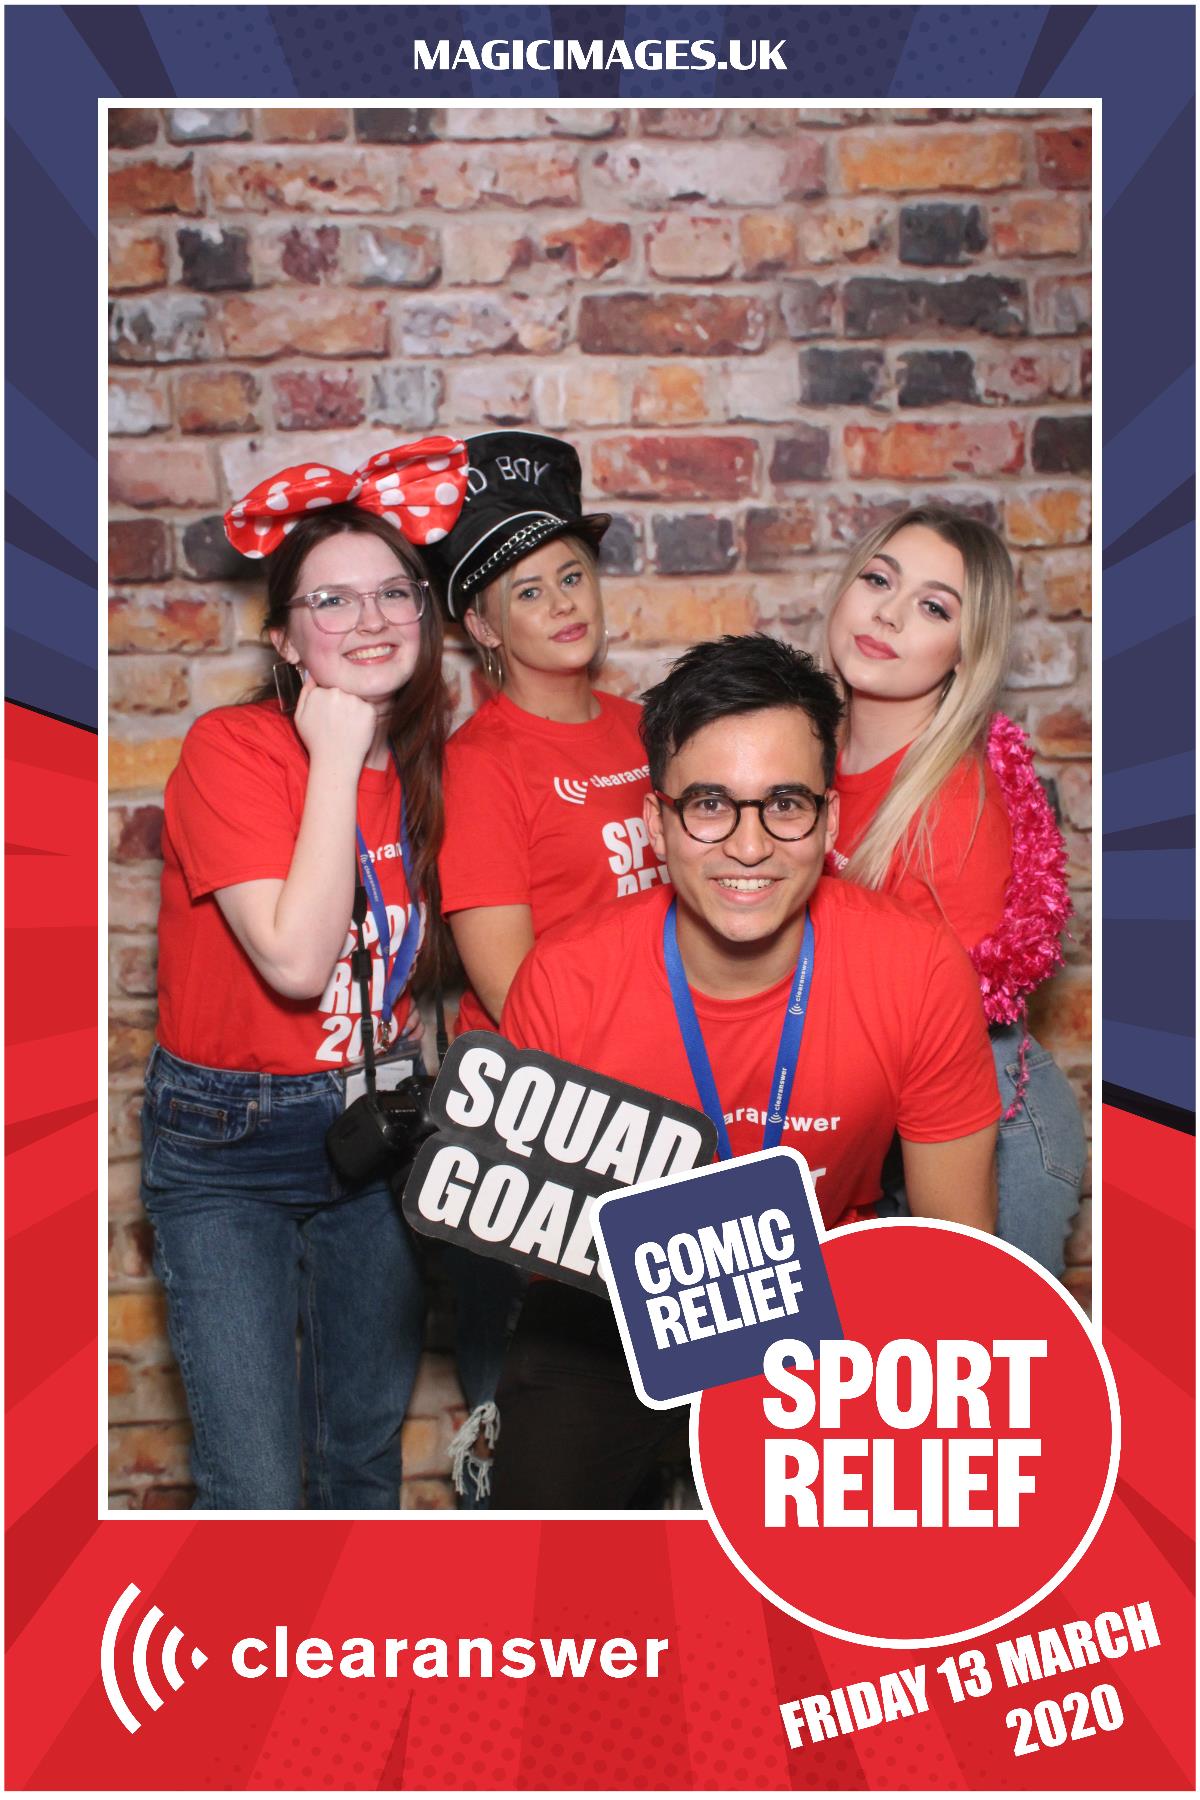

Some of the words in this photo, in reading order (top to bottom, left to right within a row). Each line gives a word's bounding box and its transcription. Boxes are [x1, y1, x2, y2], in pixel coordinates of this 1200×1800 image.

[464, 467, 487, 502] D
[495, 456, 551, 485] BOY
[590, 765, 651, 788] clearans
[602, 817, 650, 876] SP
[796, 957, 809, 1002] clearanswer
[774, 1067, 788, 1111] clearanswer
[445, 1047, 703, 1186] SQUAD
[723, 1107, 841, 1132] aranswer
[417, 1145, 606, 1281] GOAL
